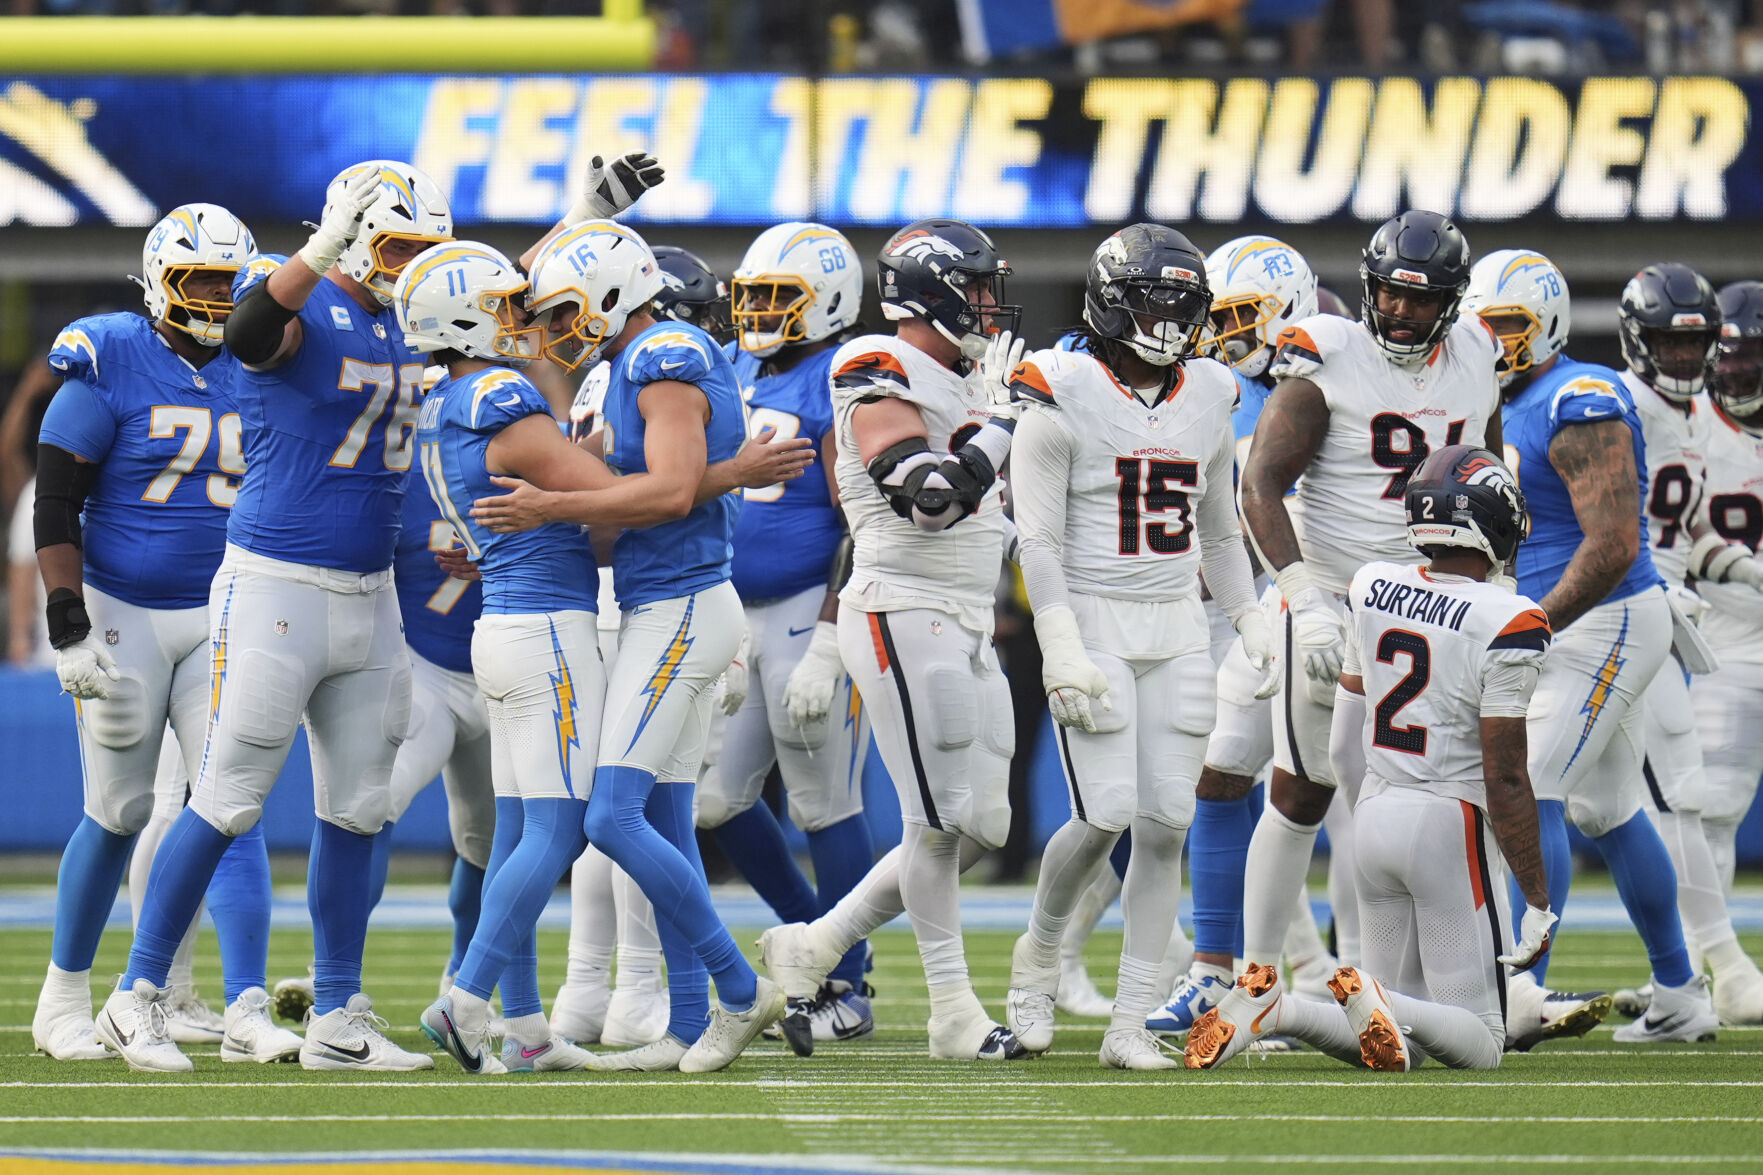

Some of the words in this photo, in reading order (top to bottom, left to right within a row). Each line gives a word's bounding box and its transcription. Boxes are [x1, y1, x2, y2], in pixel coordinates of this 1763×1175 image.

[402, 77, 714, 219] FEEL
[768, 77, 1054, 219] THE
[1081, 78, 1749, 220] THUNDER
[567, 243, 598, 277] 16
[818, 246, 847, 274] 68
[446, 268, 467, 297] 11
[1535, 272, 1561, 301] 78
[331, 307, 351, 325] C
[328, 356, 424, 471] 76
[1402, 408, 1447, 420] BRONCOS
[141, 404, 249, 507] 79
[420, 441, 482, 556] 11
[1115, 456, 1199, 556] 15
[1421, 496, 1435, 520] 2
[1364, 578, 1458, 627] SURTAIN
[1449, 601, 1472, 632] II
[1372, 627, 1431, 757] 2
